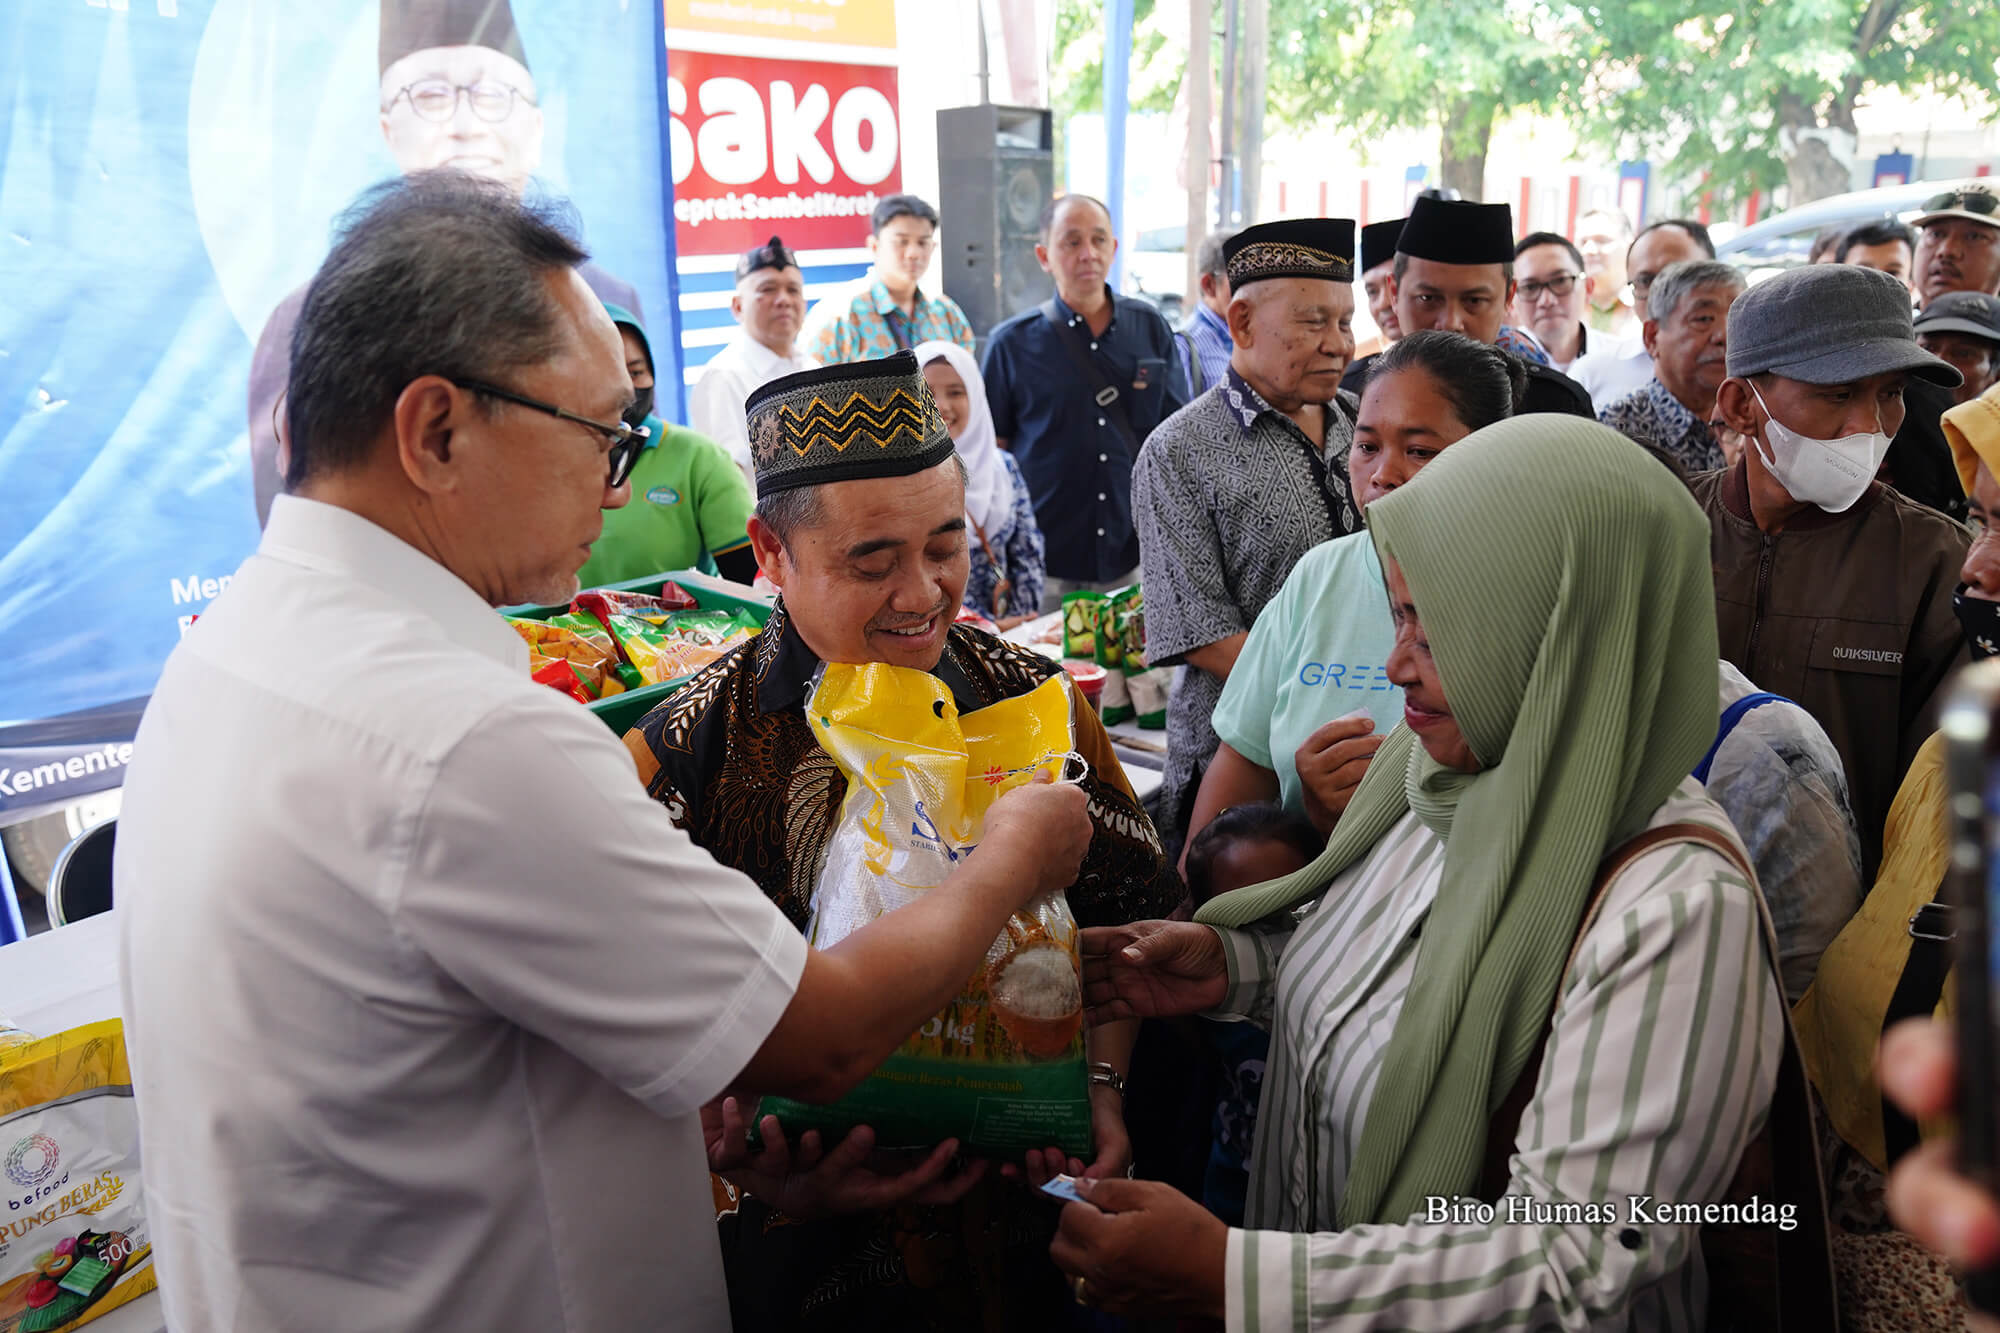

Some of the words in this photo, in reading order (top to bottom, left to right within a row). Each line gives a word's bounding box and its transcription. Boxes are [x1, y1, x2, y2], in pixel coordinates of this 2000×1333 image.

[1833, 647, 1903, 663] QUIKSILVER
[1300, 662, 1394, 690] GREE
[8, 1172, 70, 1210] befood
[60, 1171, 113, 1212] BERAS
[98, 1237, 135, 1270] 500
